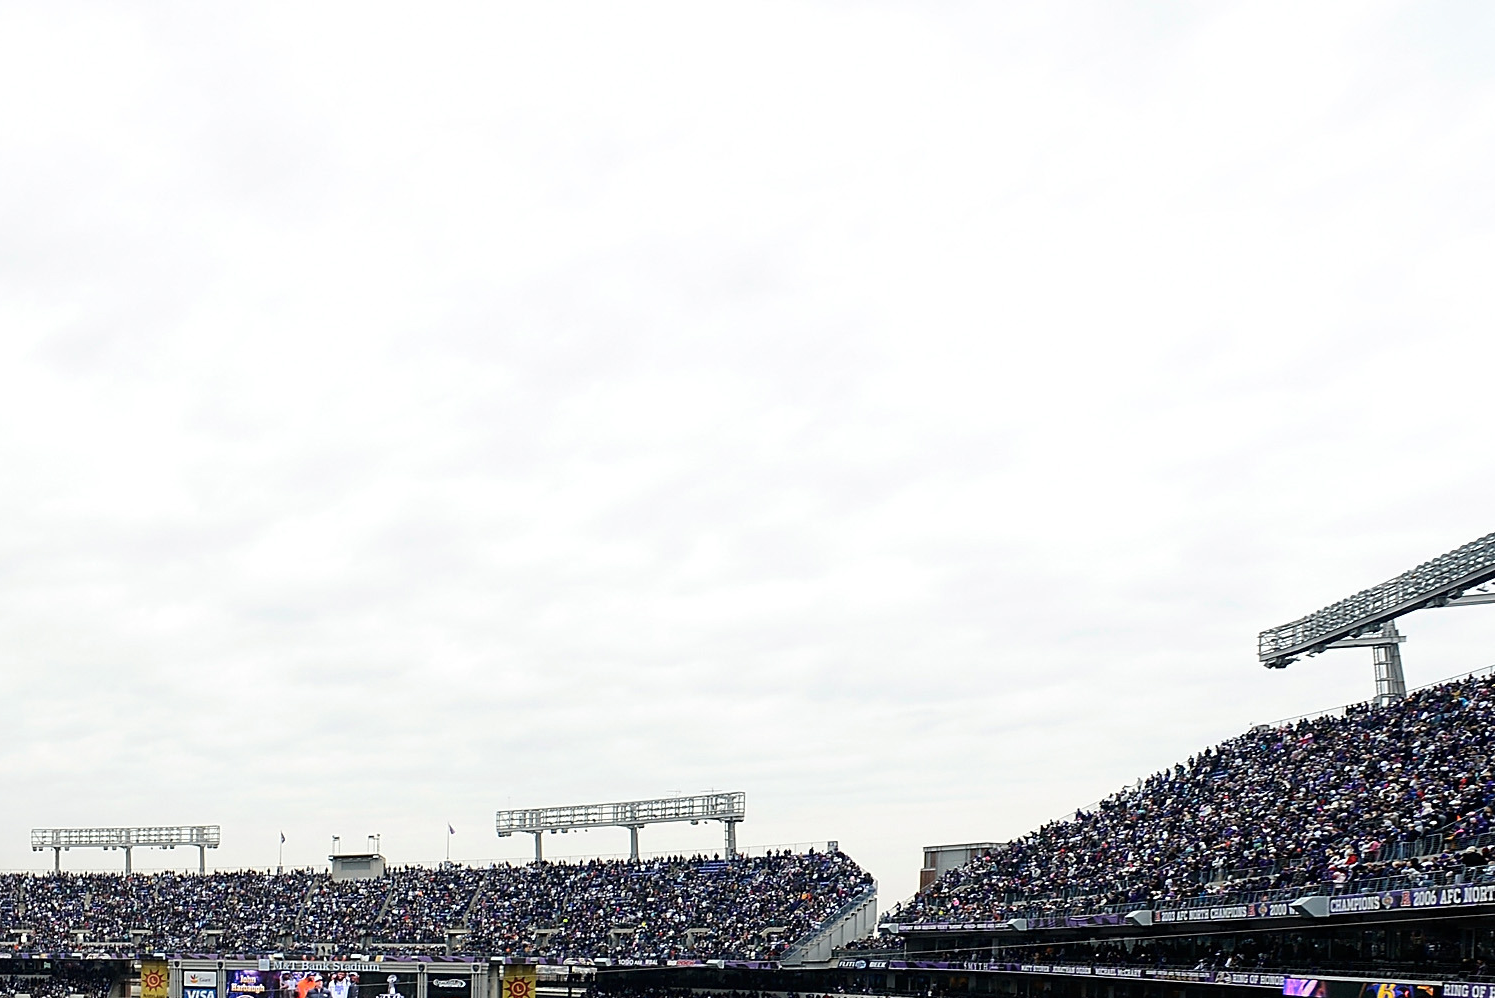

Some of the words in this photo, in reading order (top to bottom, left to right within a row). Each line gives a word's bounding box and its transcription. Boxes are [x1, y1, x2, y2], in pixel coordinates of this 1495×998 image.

[1413, 890, 1437, 907] 2006
[1439, 887, 1462, 904] AFC
[1270, 903, 1287, 916] 2000
[1330, 896, 1381, 913] CHAMPIONS
[1162, 911, 1176, 922] 2003
[1176, 910, 1188, 921] AFC
[1189, 909, 1210, 921] NORTH
[1210, 906, 1247, 920] CHAMPIONS
[273, 961, 297, 970] M&T
[301, 961, 330, 971] Bank
[333, 961, 380, 972] Stadium
[240, 974, 257, 985] John
[1232, 974, 1248, 984] RING
[1249, 975, 1259, 984] OF
[231, 983, 265, 994] Harbaugh
[1443, 983, 1468, 997] RING
[1471, 986, 1487, 998] OF
